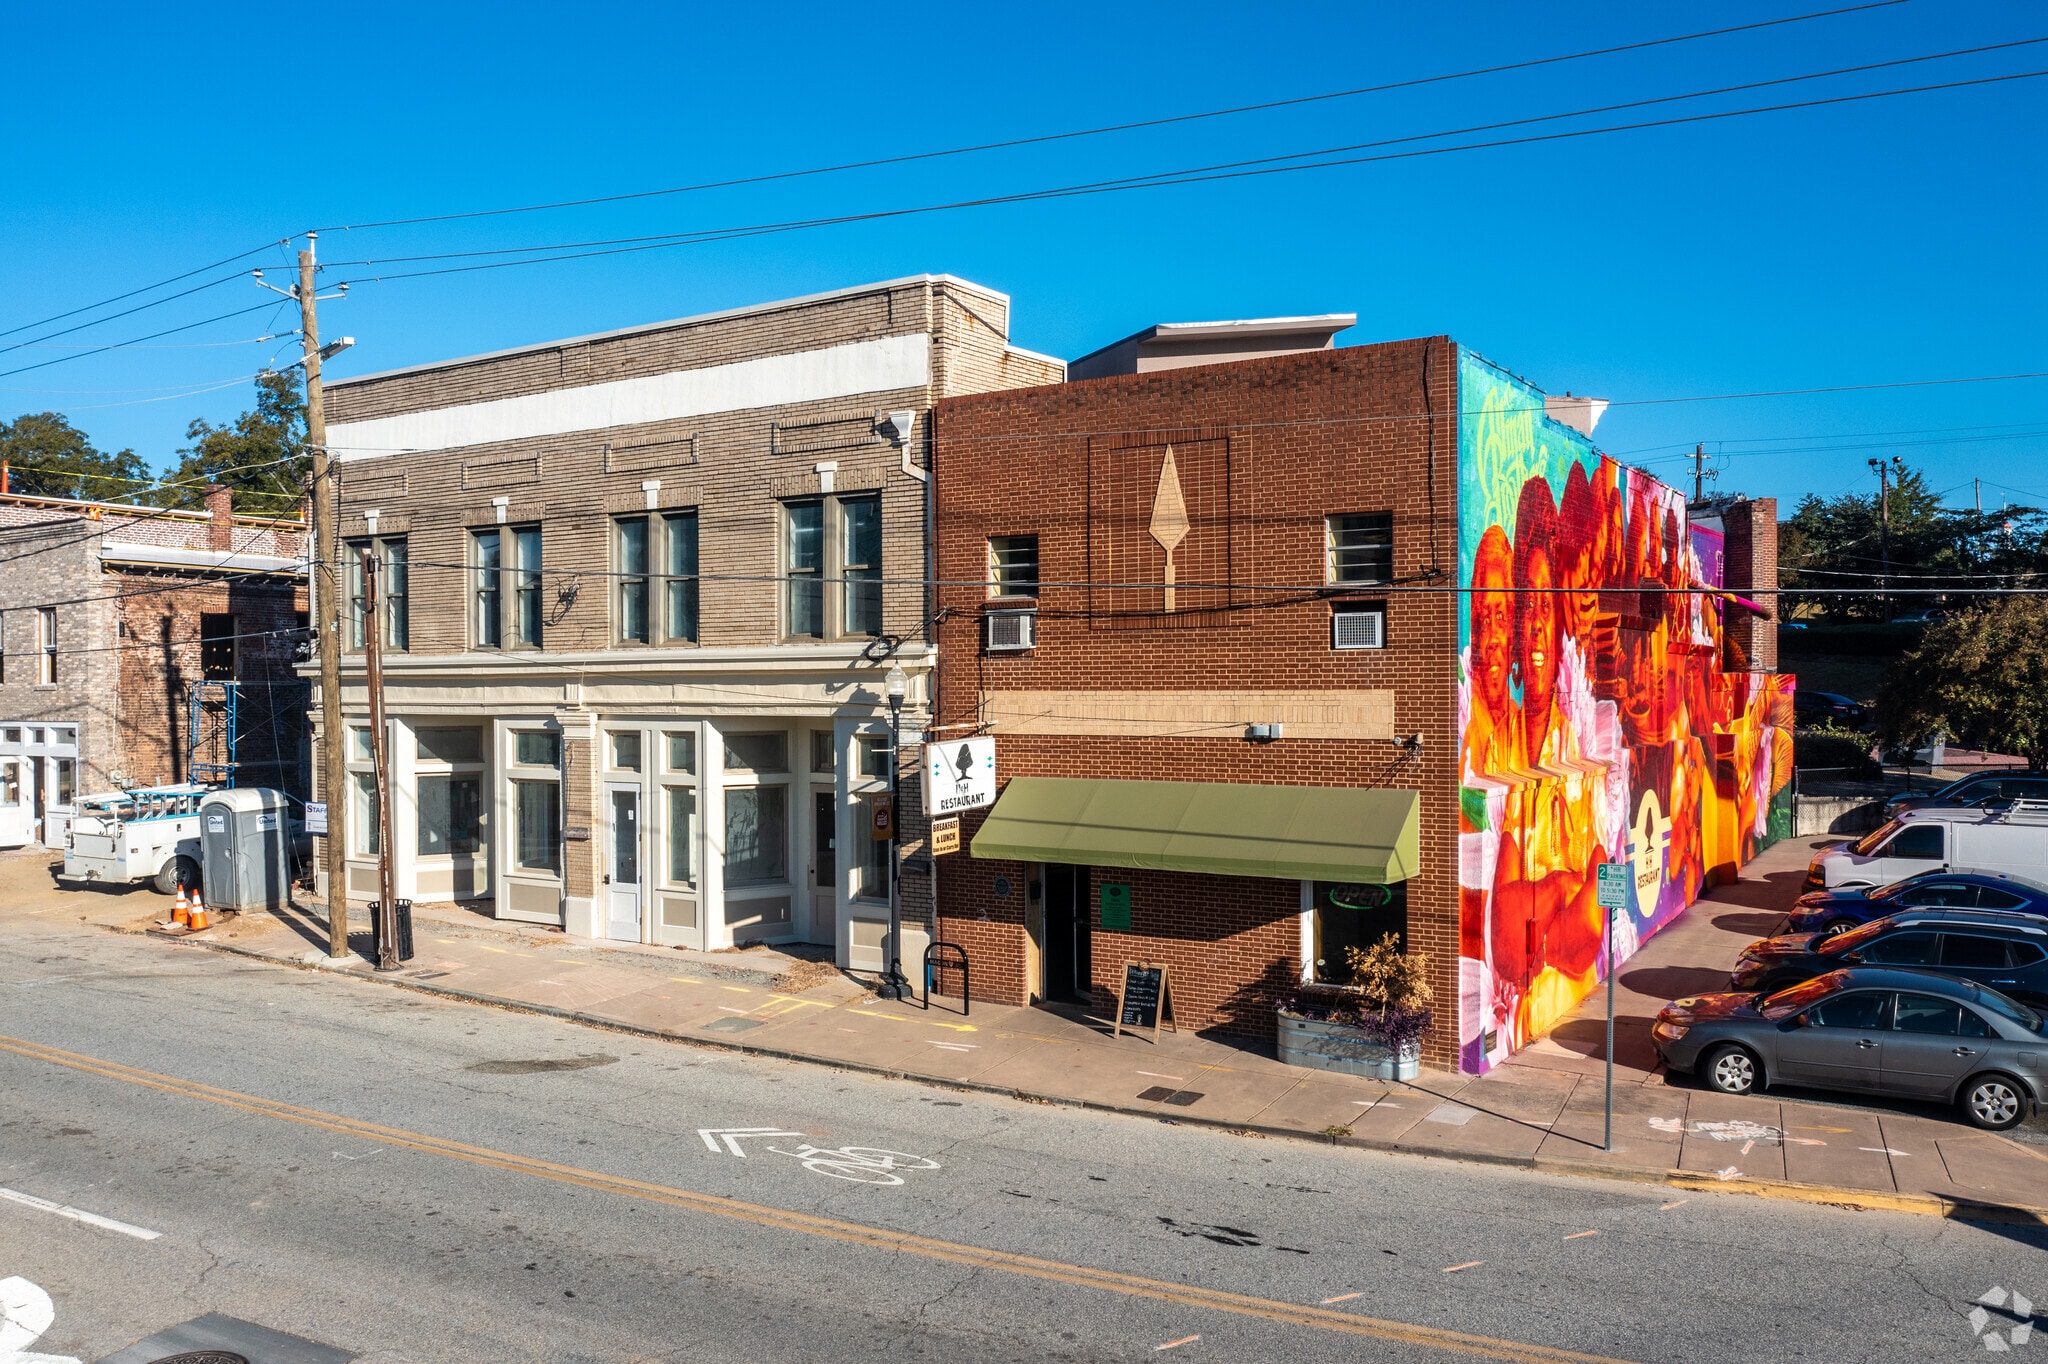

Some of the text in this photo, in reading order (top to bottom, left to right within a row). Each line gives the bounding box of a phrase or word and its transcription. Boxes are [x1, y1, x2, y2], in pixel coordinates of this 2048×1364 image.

[940, 793, 985, 810] RESTAURANT
[933, 820, 958, 833] BREAKFAST
[936, 832, 956, 844] & LUNCH
[1599, 866, 1606, 878] 2
[1637, 867, 1660, 890] RESTAURANT
[1333, 884, 1386, 907] OPEN
